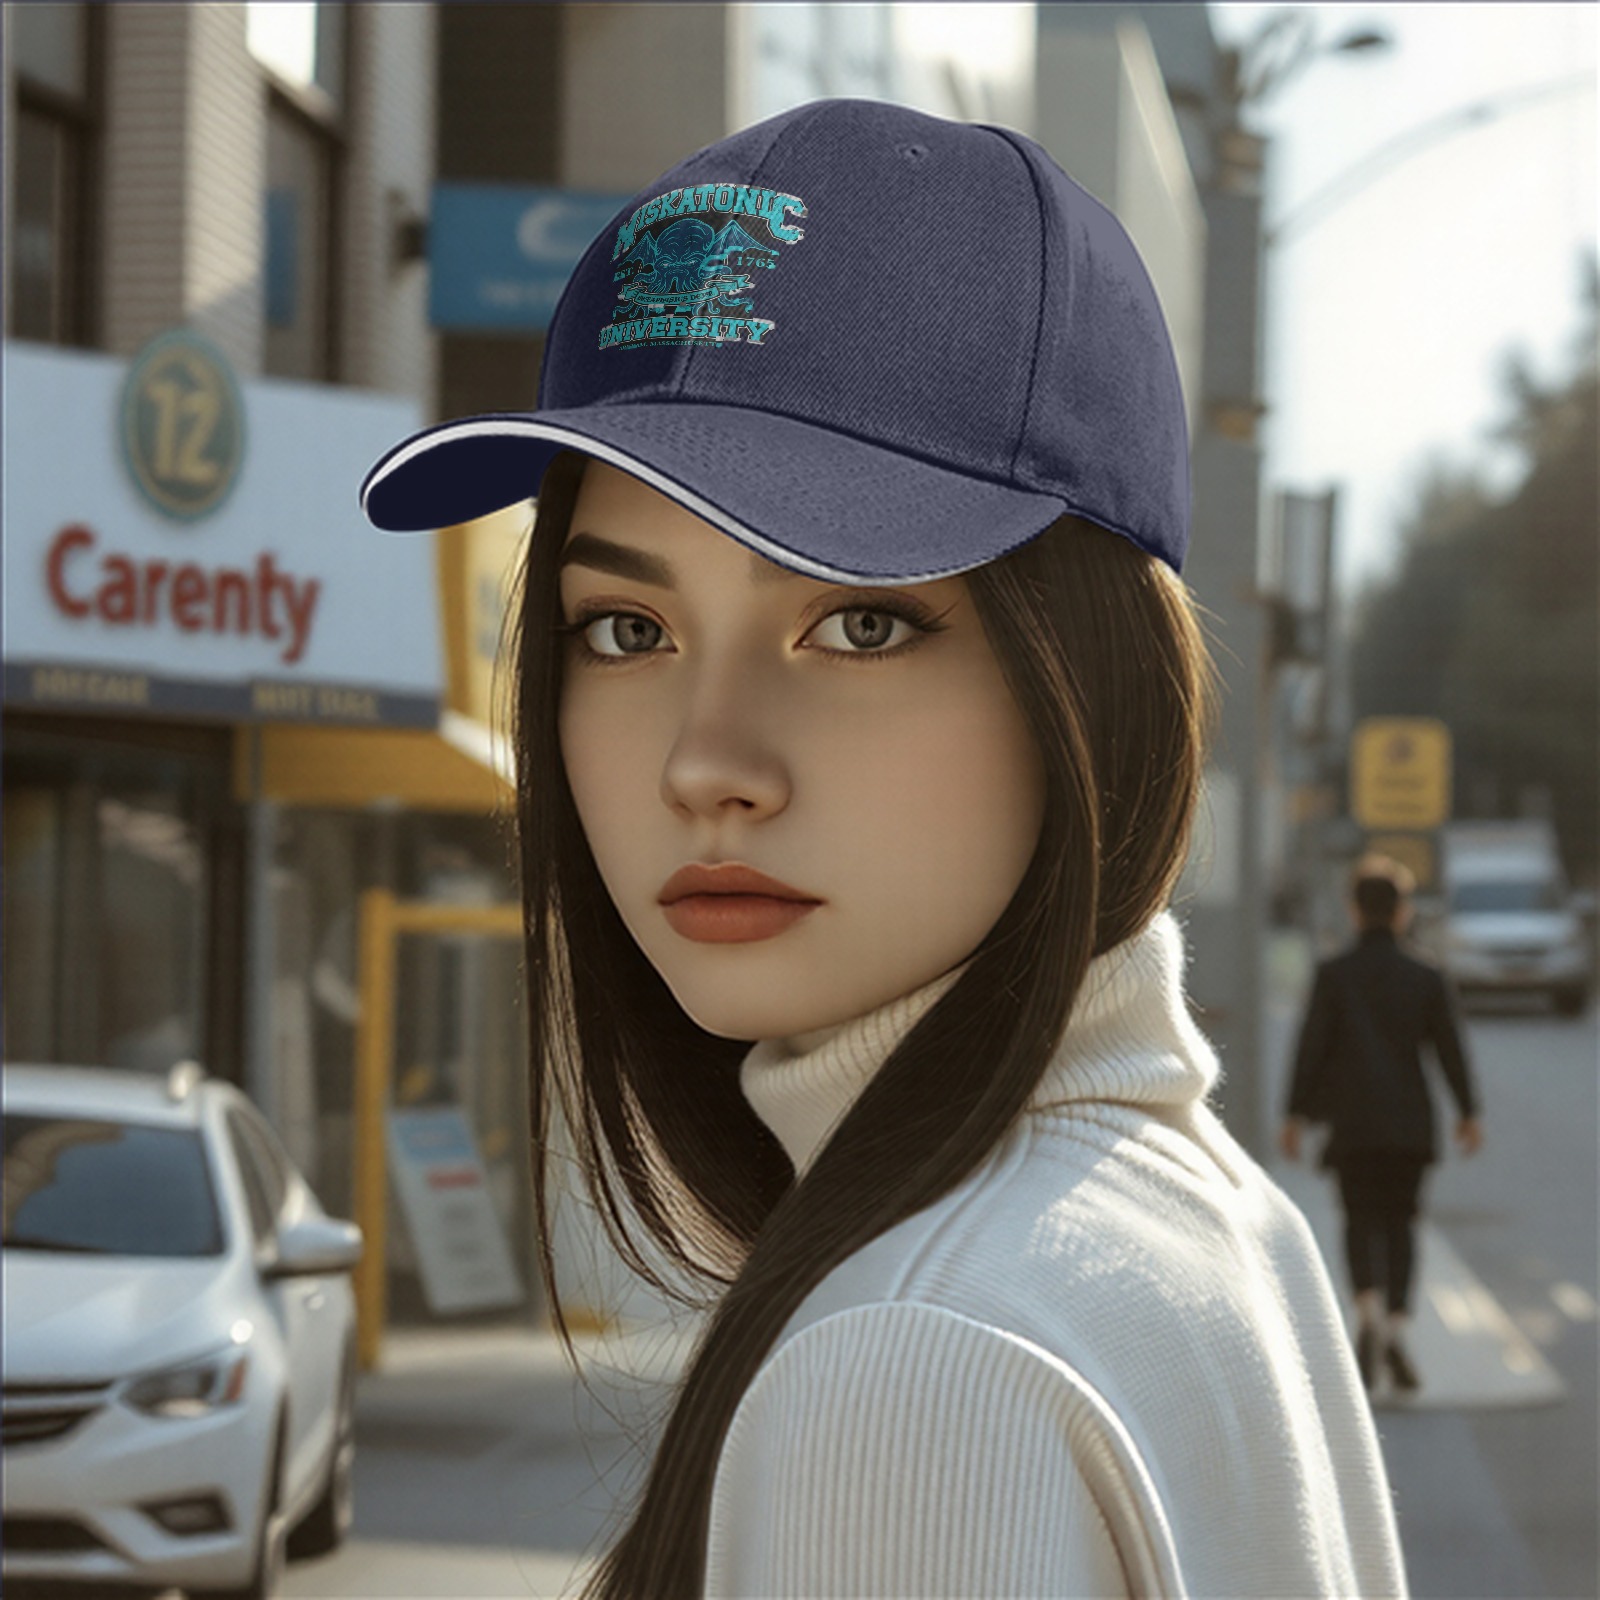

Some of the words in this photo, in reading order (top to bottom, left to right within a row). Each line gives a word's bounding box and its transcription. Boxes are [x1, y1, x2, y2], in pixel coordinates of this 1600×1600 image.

[611, 183, 808, 263] MISKATONIC
[736, 256, 776, 270] 1765
[599, 316, 775, 350] UNIVERSITY
[148, 378, 222, 486] 12
[45, 523, 320, 665] Carenty
